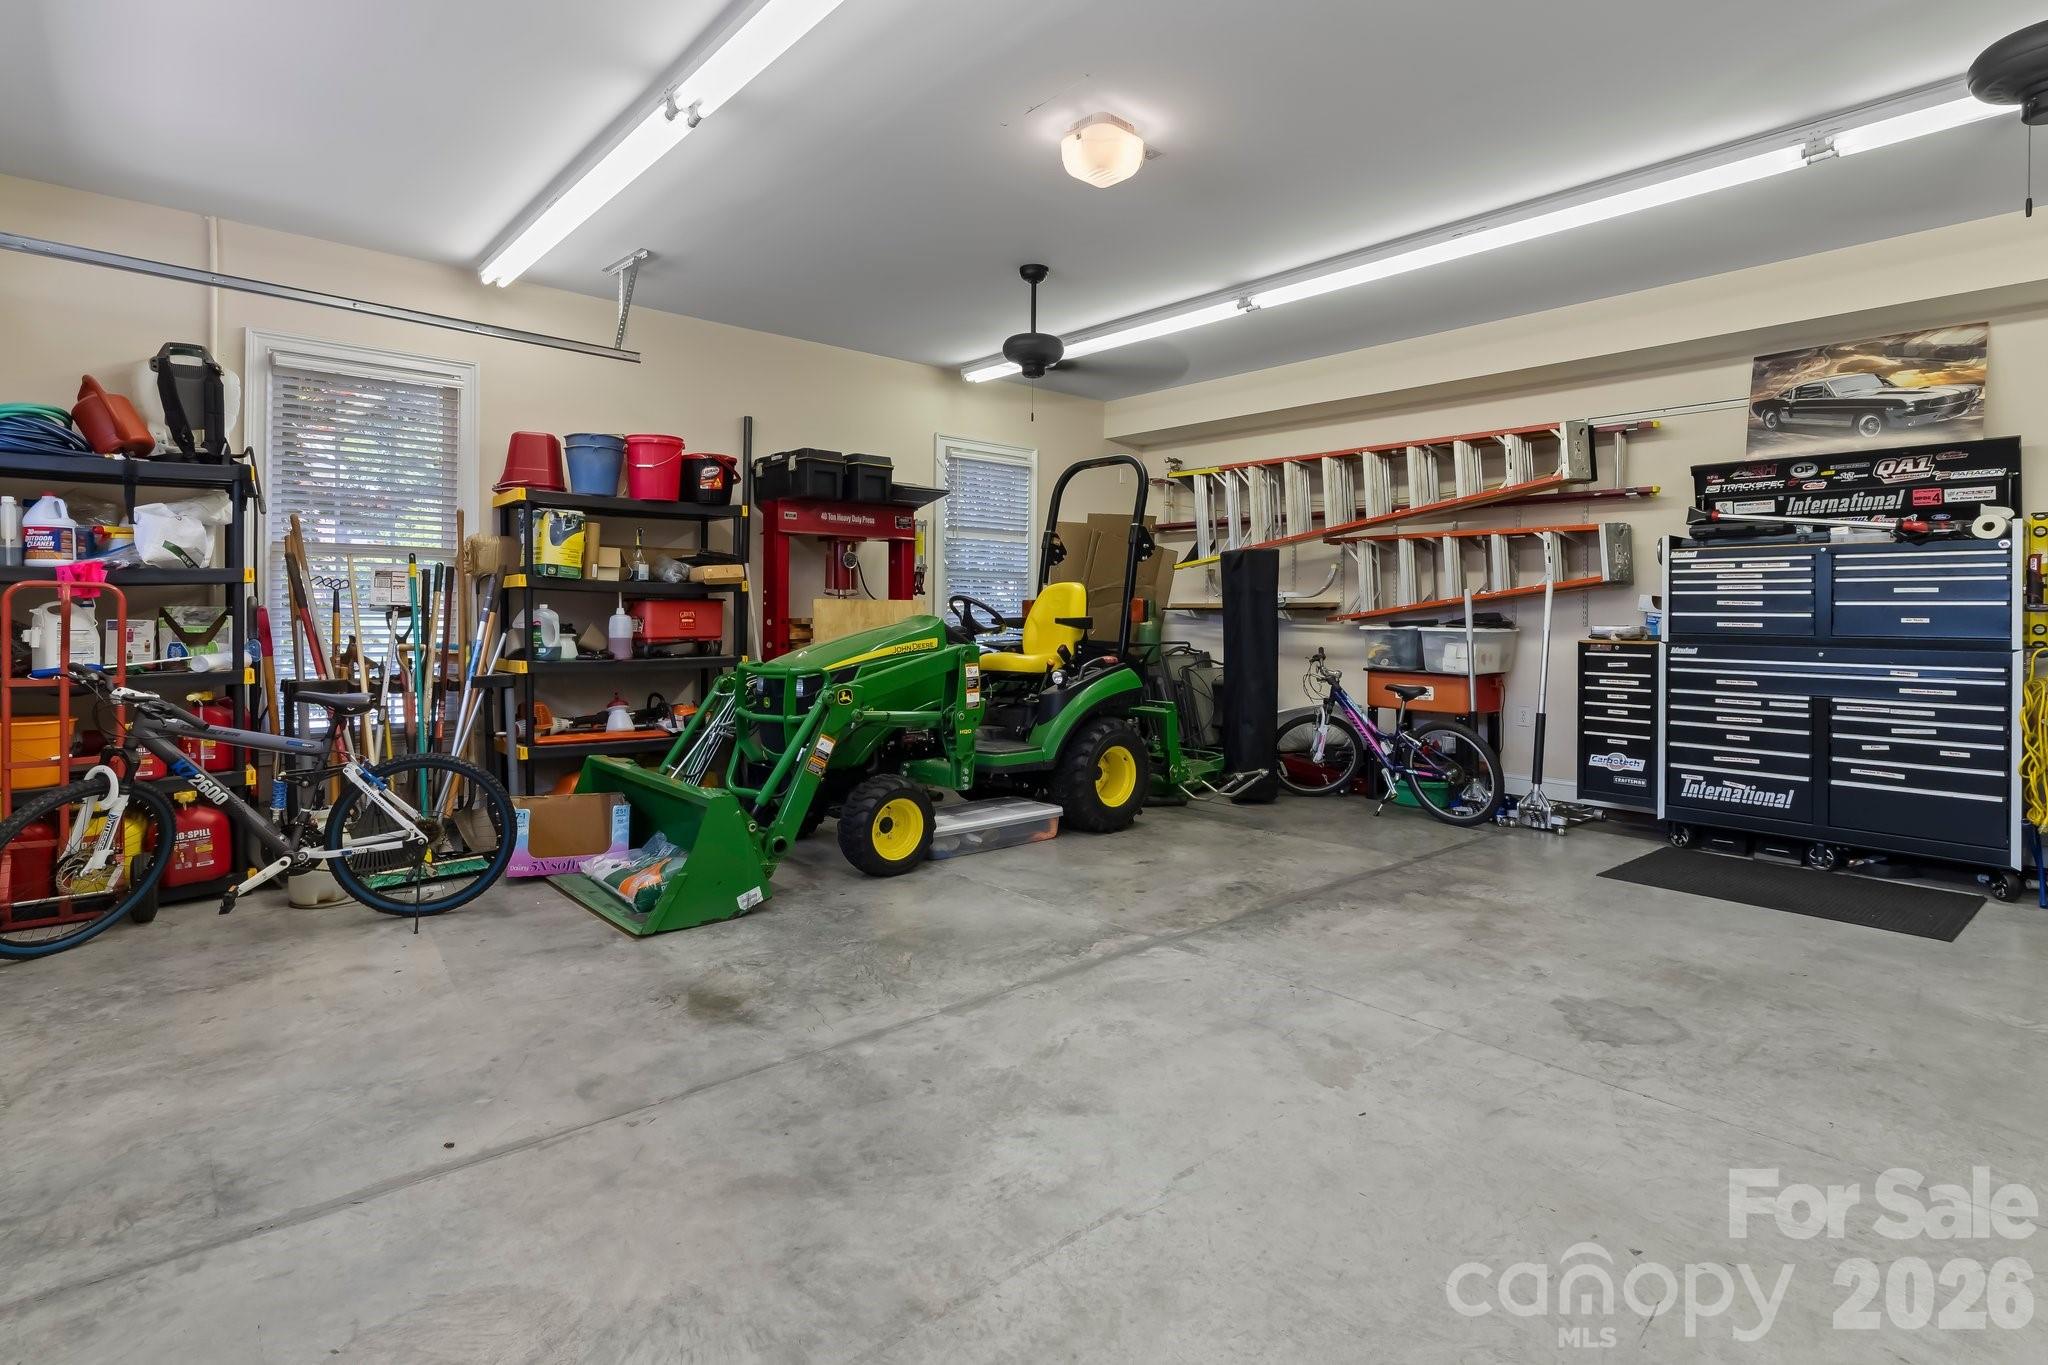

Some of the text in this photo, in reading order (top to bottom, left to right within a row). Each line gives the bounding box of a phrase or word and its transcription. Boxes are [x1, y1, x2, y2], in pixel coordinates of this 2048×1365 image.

[1876, 457, 1931, 478] QA1
[1951, 467, 2007, 479] PARAGON
[1722, 480, 1785, 490] TRACKSPEC
[1785, 490, 1905, 515] International
[1932, 493, 1940, 503] 4
[828, 512, 837, 521] Ton
[837, 513, 851, 523] Heavy
[851, 514, 862, 524] Duty
[862, 515, 875, 525] Press
[893, 642, 934, 654] JOHN DEERE
[1591, 755, 1640, 767] Carbotech
[1614, 777, 1646, 786] CRAFTSMAN
[1681, 778, 1794, 809] International
